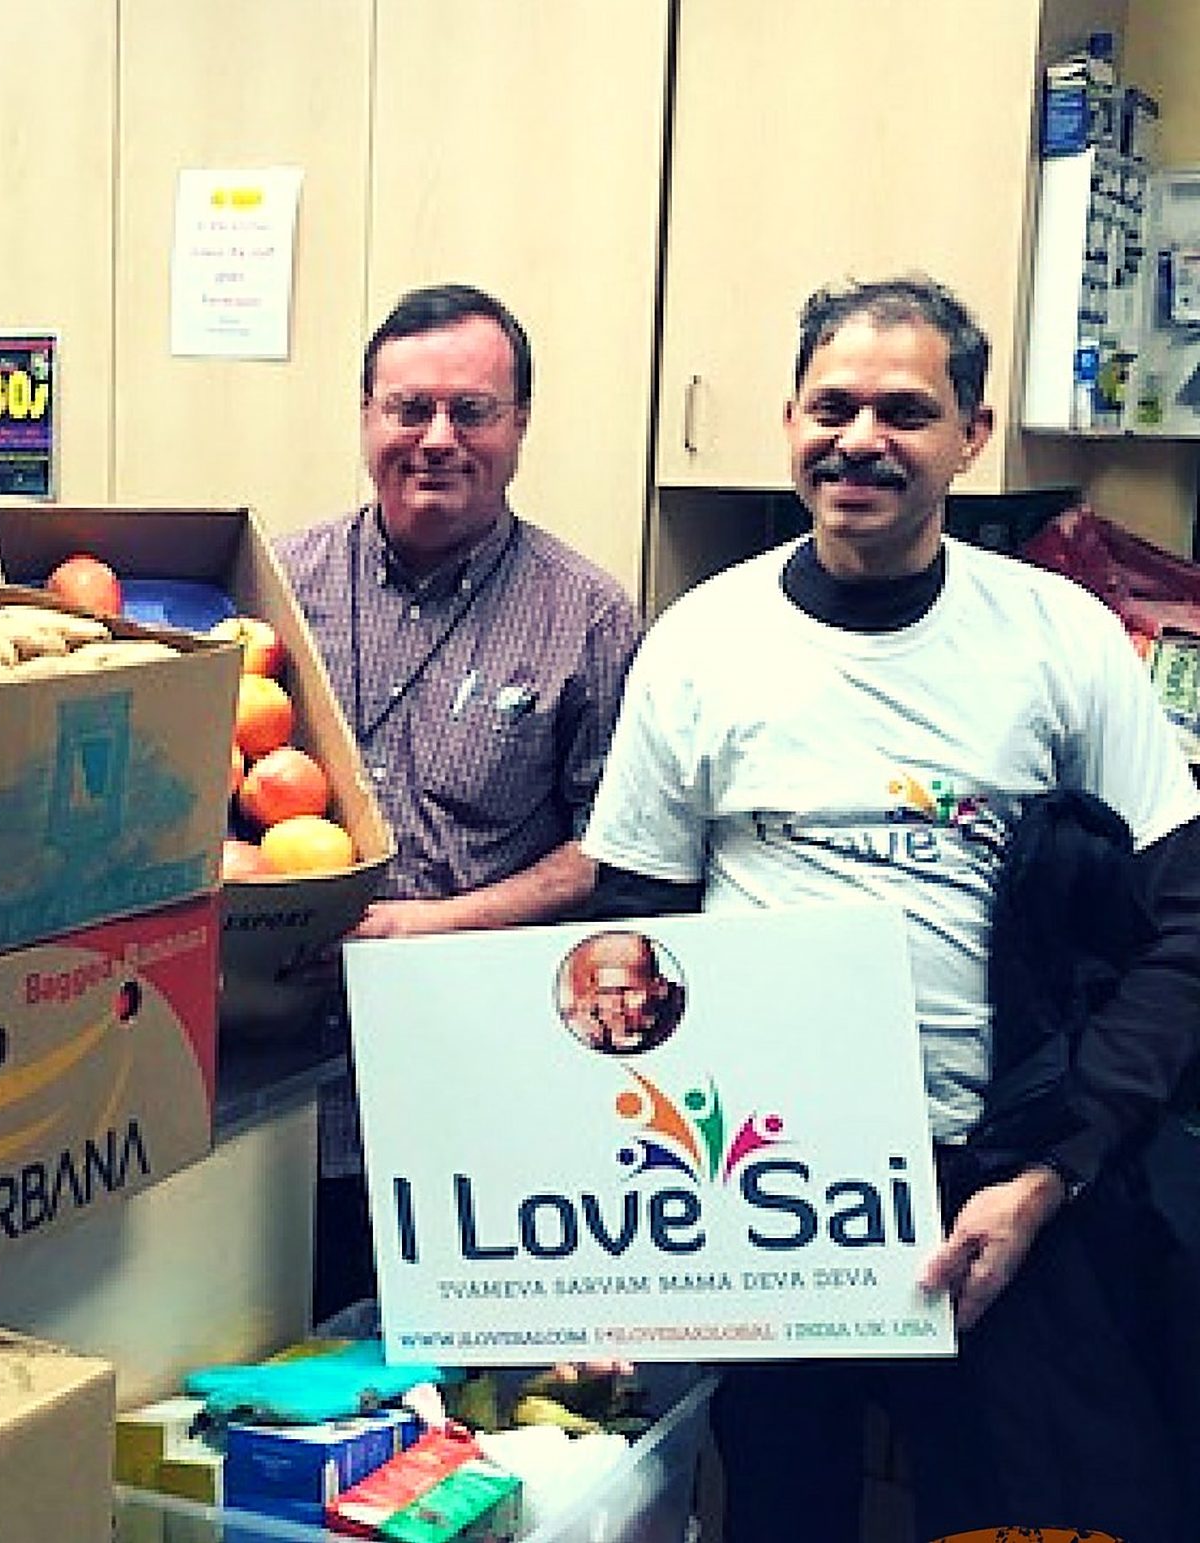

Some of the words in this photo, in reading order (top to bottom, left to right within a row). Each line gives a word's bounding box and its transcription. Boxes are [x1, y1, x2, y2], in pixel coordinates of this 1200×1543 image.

[392, 1174, 420, 1265] I
[452, 1172, 707, 1262] Love
[737, 1154, 917, 1252] Sai
[657, 1272, 734, 1292] MAMA
[741, 1271, 805, 1290] DEVA
[812, 1267, 878, 1287] DEVA
